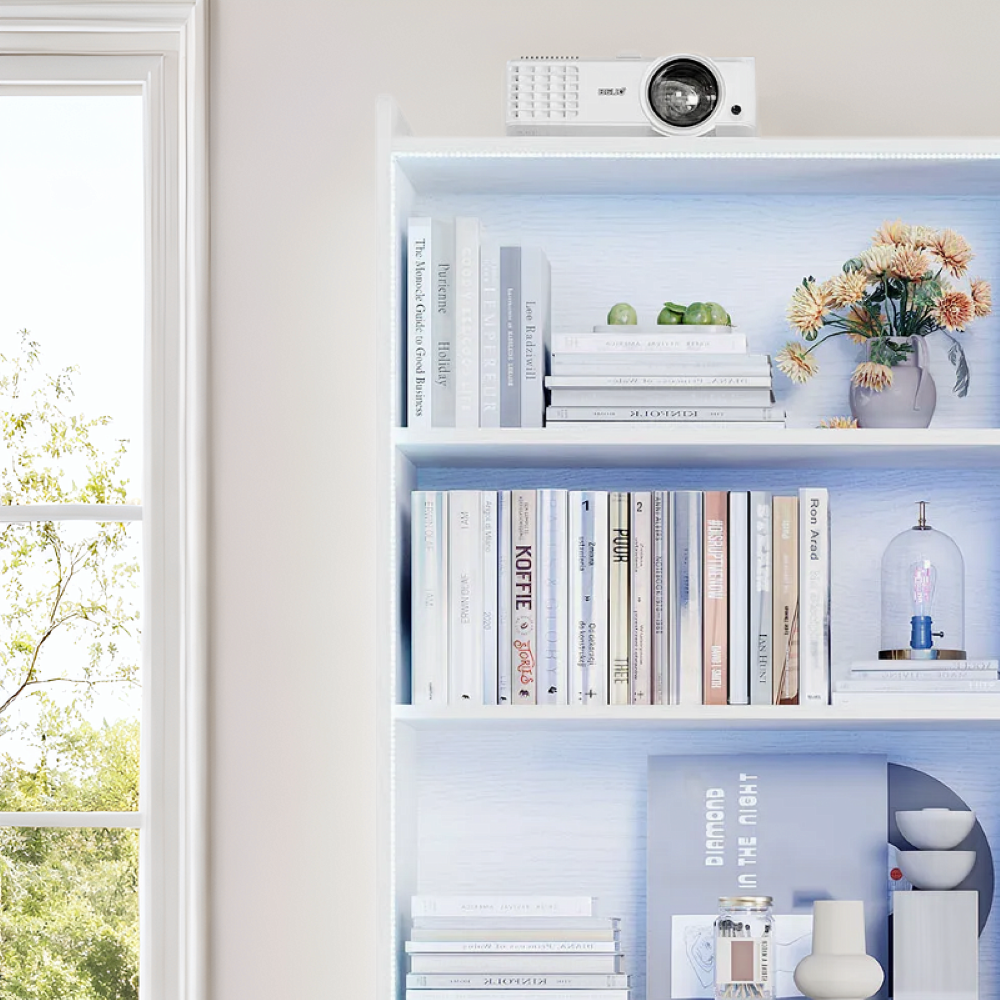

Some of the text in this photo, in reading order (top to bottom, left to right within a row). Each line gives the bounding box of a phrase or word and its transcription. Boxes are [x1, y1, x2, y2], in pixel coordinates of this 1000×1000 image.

[414, 238, 426, 417] The Monocle Guide to Good Business
[525, 301, 537, 380] Lee Radziwill
[435, 341, 451, 388] Holiday
[708, 520, 723, 600] #DISRUPTMENOW
[810, 498, 820, 561] Ron Arad
[516, 545, 532, 611] KOFFIE
[484, 612, 492, 631] 2020
[513, 640, 535, 685] STORIES
[738, 772, 759, 888] IN THE NIGHT
